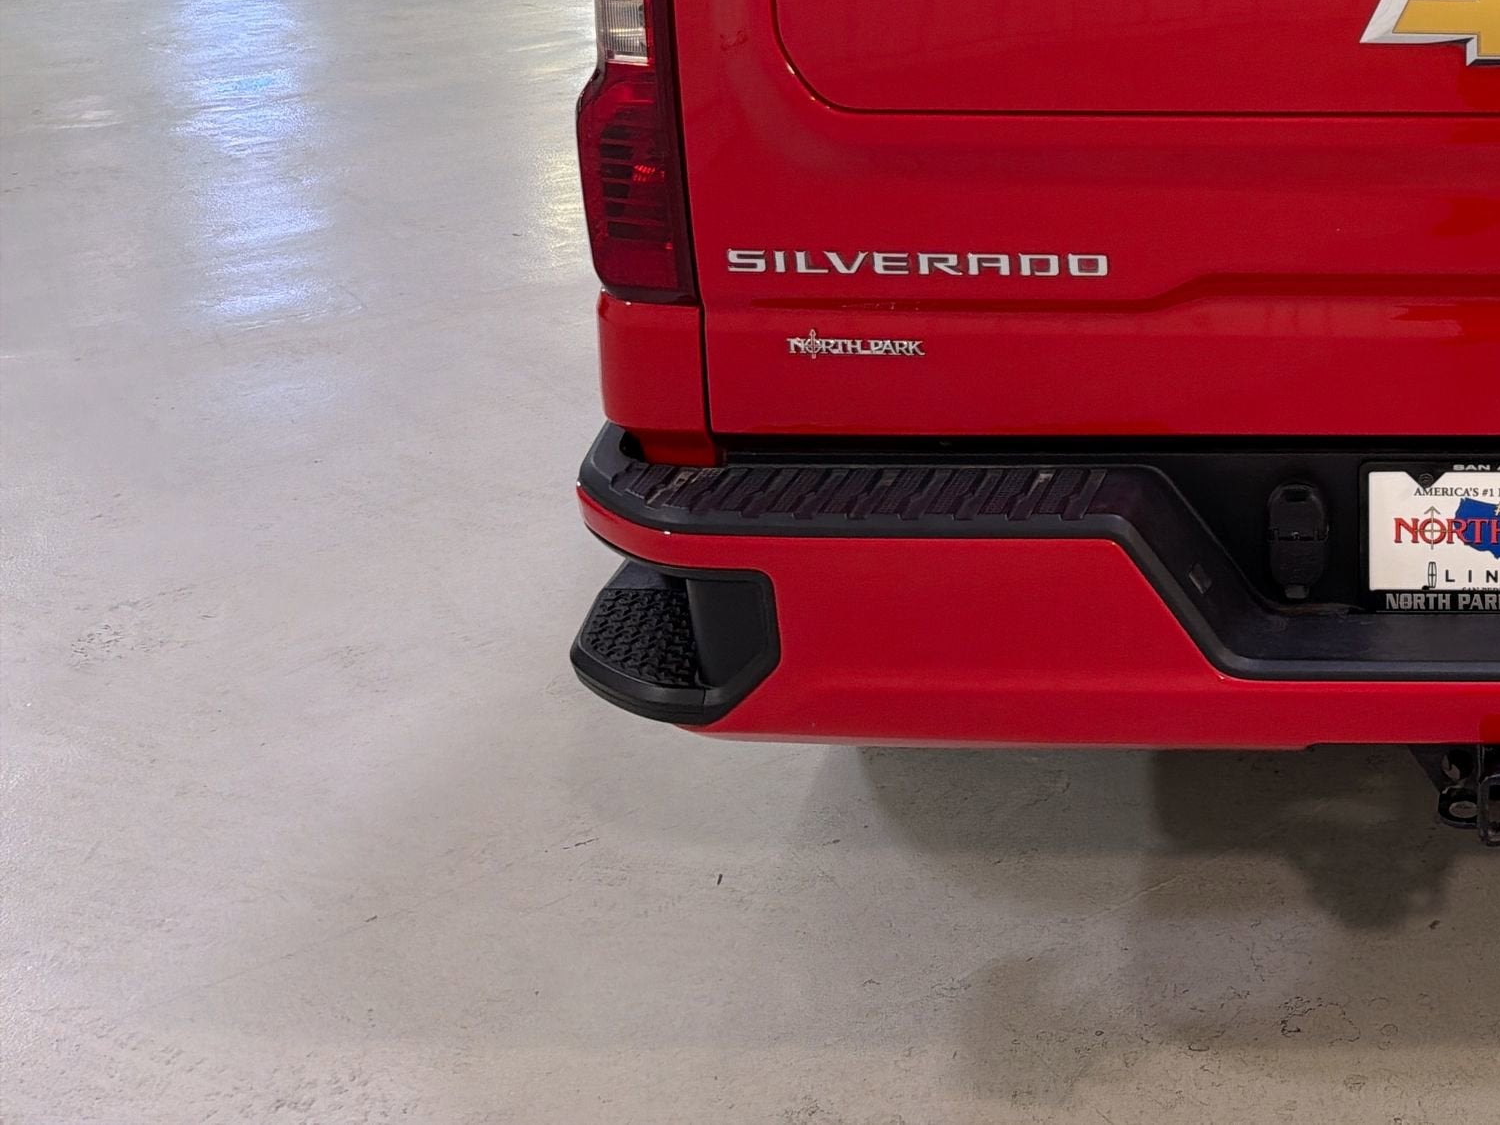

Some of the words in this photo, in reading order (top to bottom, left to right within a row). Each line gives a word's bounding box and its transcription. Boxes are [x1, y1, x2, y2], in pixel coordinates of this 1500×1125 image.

[727, 248, 1109, 276] SILVERADO
[786, 329, 862, 359] NORTH
[869, 339, 925, 356] PARK
[1453, 464, 1490, 472] SAN
[1413, 487, 1479, 498] AMERICA'S
[1482, 487, 1494, 497] #1
[1385, 593, 1450, 609] NORTH
